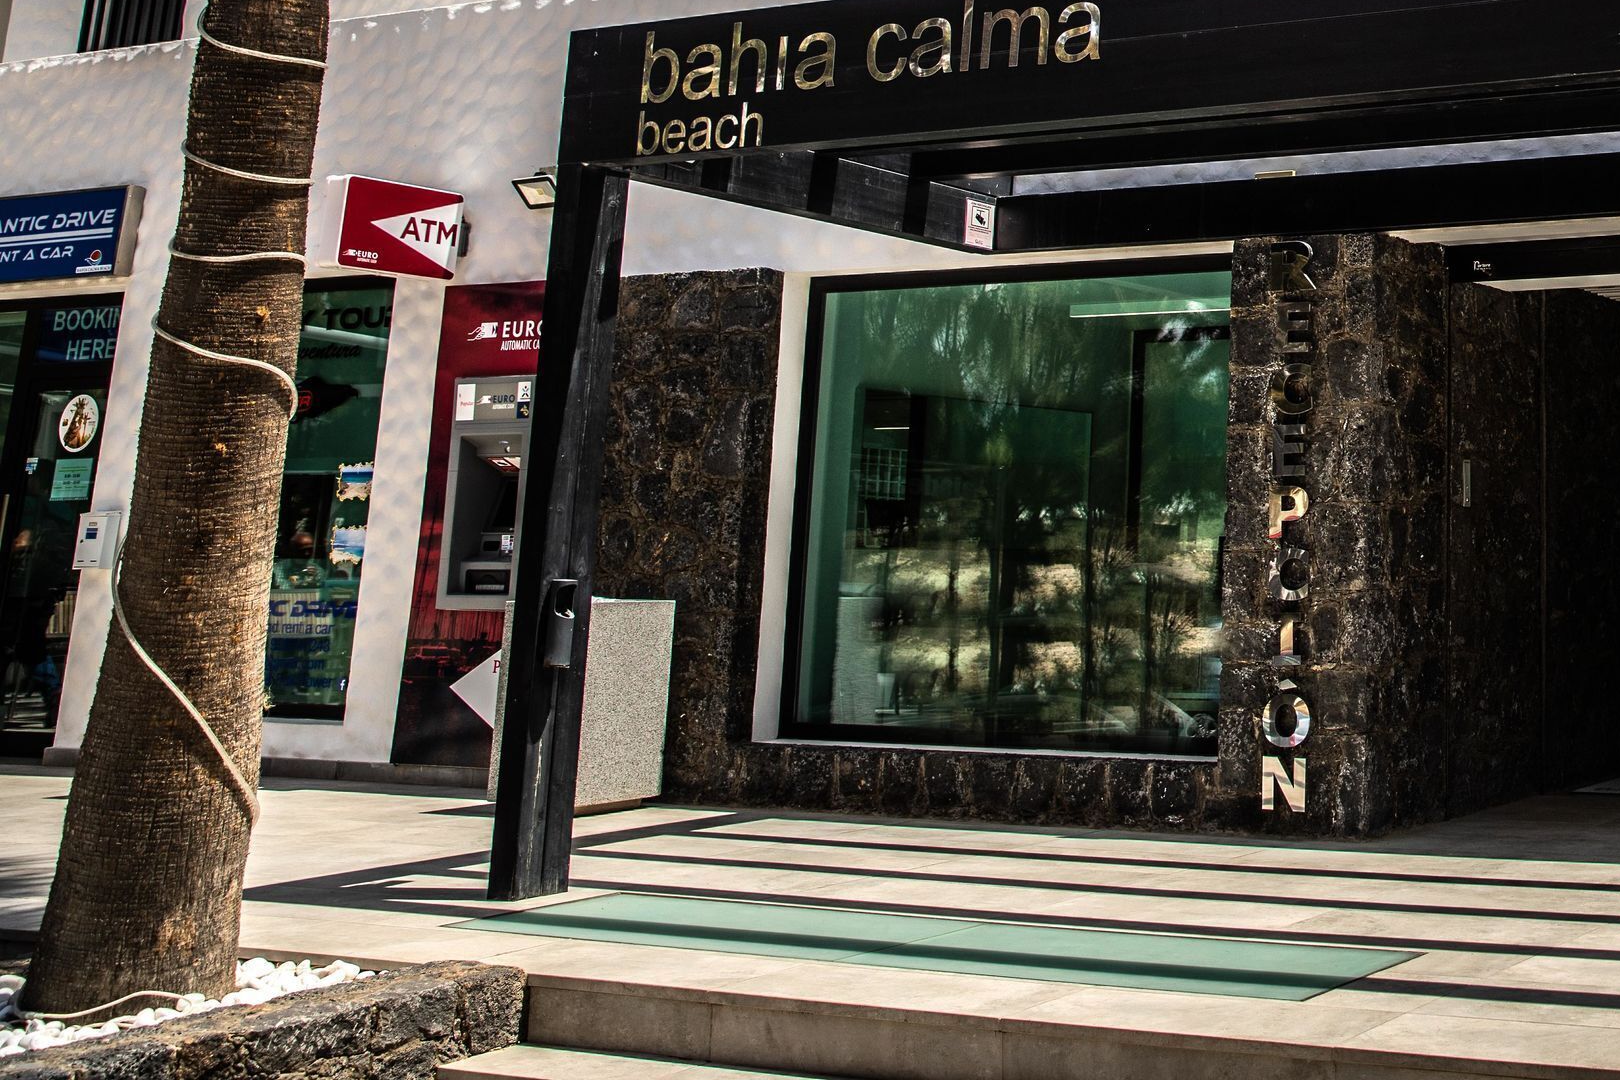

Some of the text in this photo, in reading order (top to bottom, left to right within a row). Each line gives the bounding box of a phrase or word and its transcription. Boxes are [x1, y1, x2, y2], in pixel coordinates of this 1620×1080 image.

[635, 101, 765, 155] beach
[52, 208, 117, 229] DRIVE
[400, 216, 458, 248] ATM
[23, 248, 35, 261] A
[39, 245, 74, 259] CAR
[357, 250, 379, 260] EURO
[66, 338, 116, 361] HERE
[500, 339, 532, 351] AUTOMATIC
[493, 394, 516, 403] EURO
[1260, 240, 1317, 813] RECEPCIÓN
[315, 624, 335, 635] car
